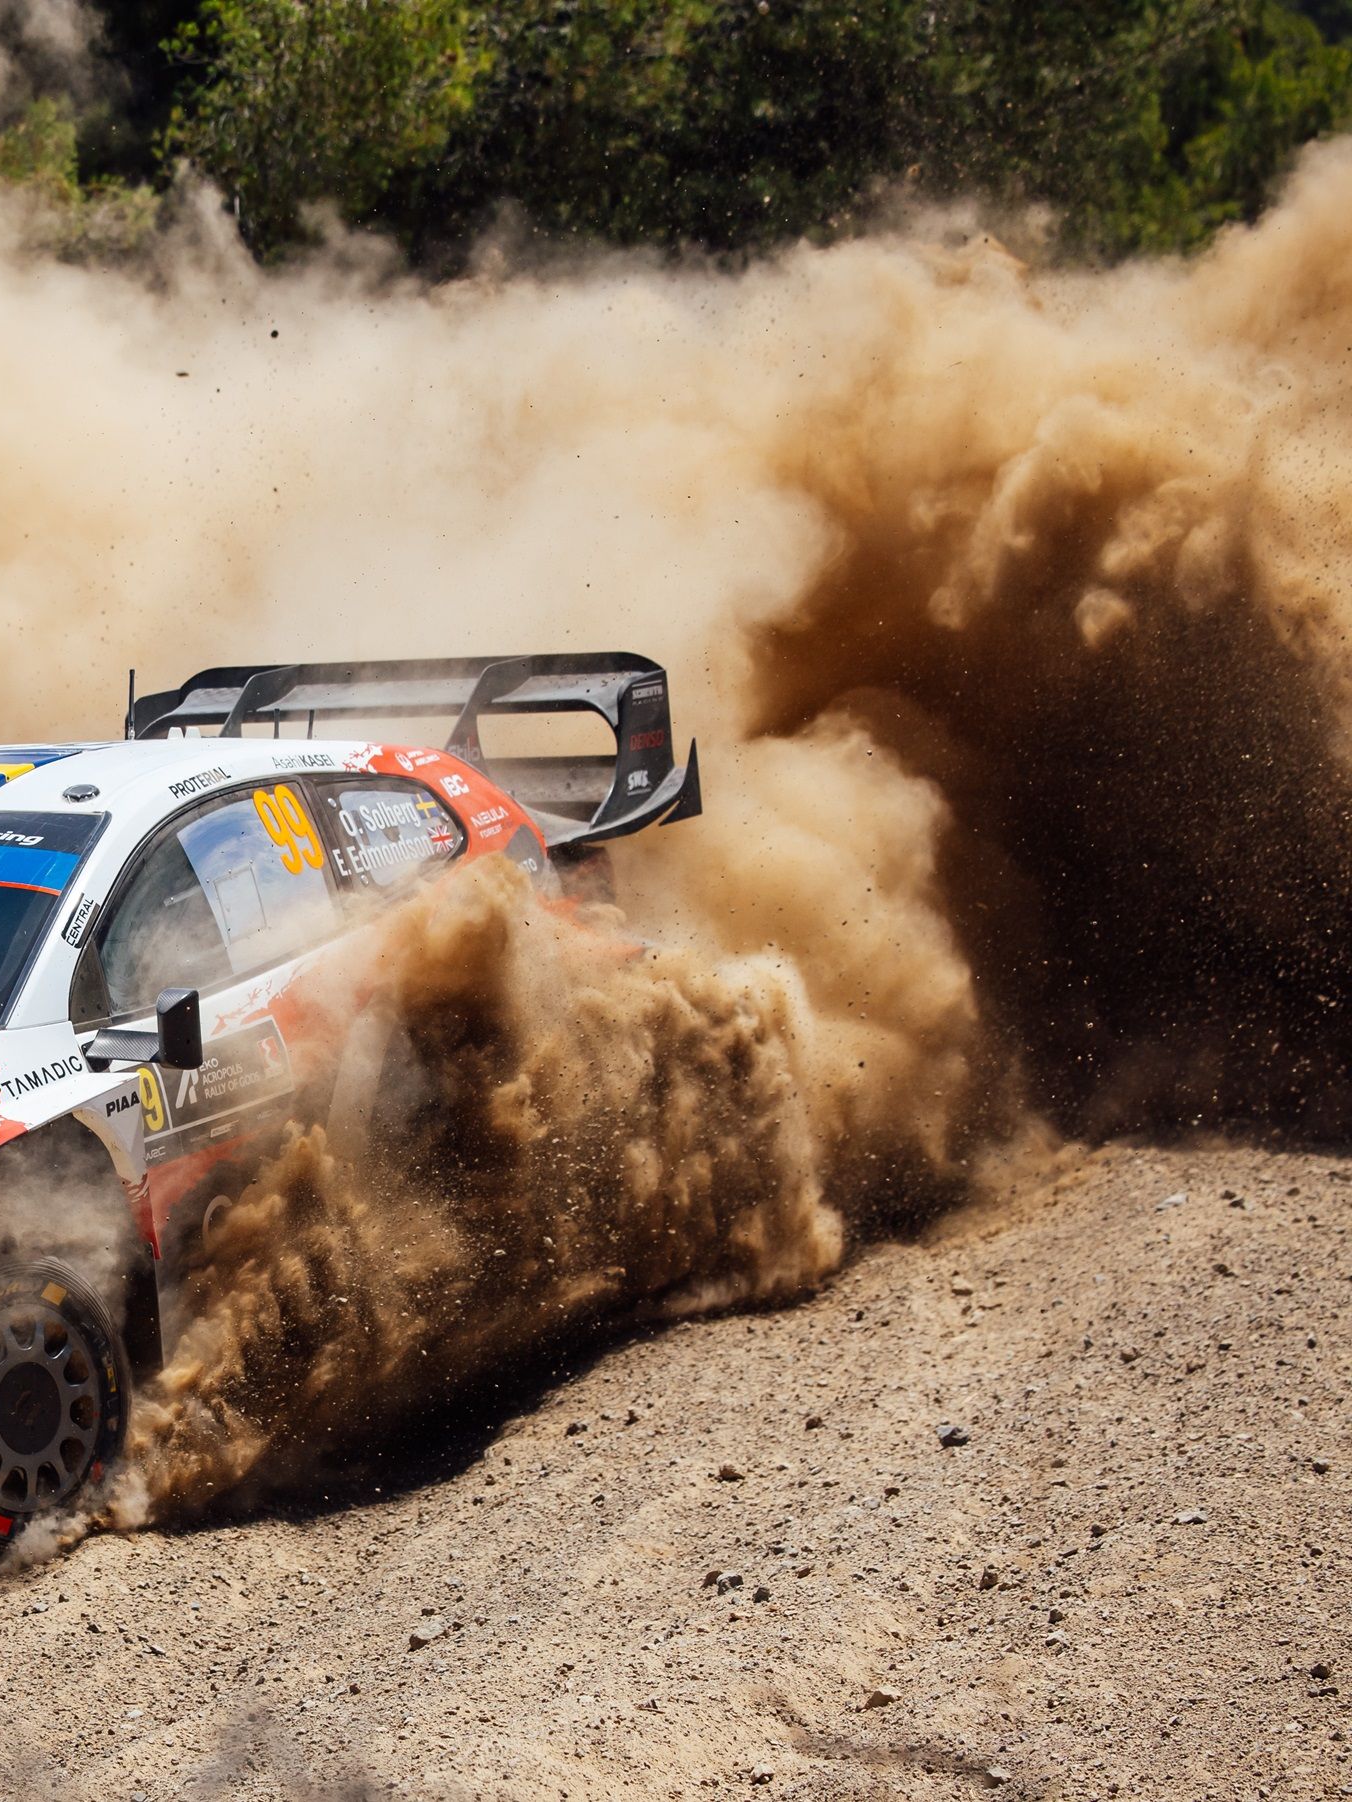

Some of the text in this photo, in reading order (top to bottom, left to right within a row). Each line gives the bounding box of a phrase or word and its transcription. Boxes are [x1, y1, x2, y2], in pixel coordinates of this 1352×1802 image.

[629, 728, 665, 753] DENSO
[272, 754, 335, 769] AsahiKASEI
[168, 767, 232, 798] PROTERIAL
[253, 784, 324, 875] 99
[339, 798, 422, 837] O. Solberg
[470, 806, 509, 828] NEULA
[332, 833, 436, 877] E. Edmondson
[66, 899, 95, 947] CENTRAL
[1, 1055, 84, 1099] TAMADIC
[199, 1058, 219, 1072] EKO
[202, 1063, 244, 1085] ACROPOLIS
[204, 1082, 227, 1099] RALLY
[227, 1079, 240, 1091] OF
[239, 1071, 260, 1087] GODS
[106, 1090, 141, 1117] PIAA
